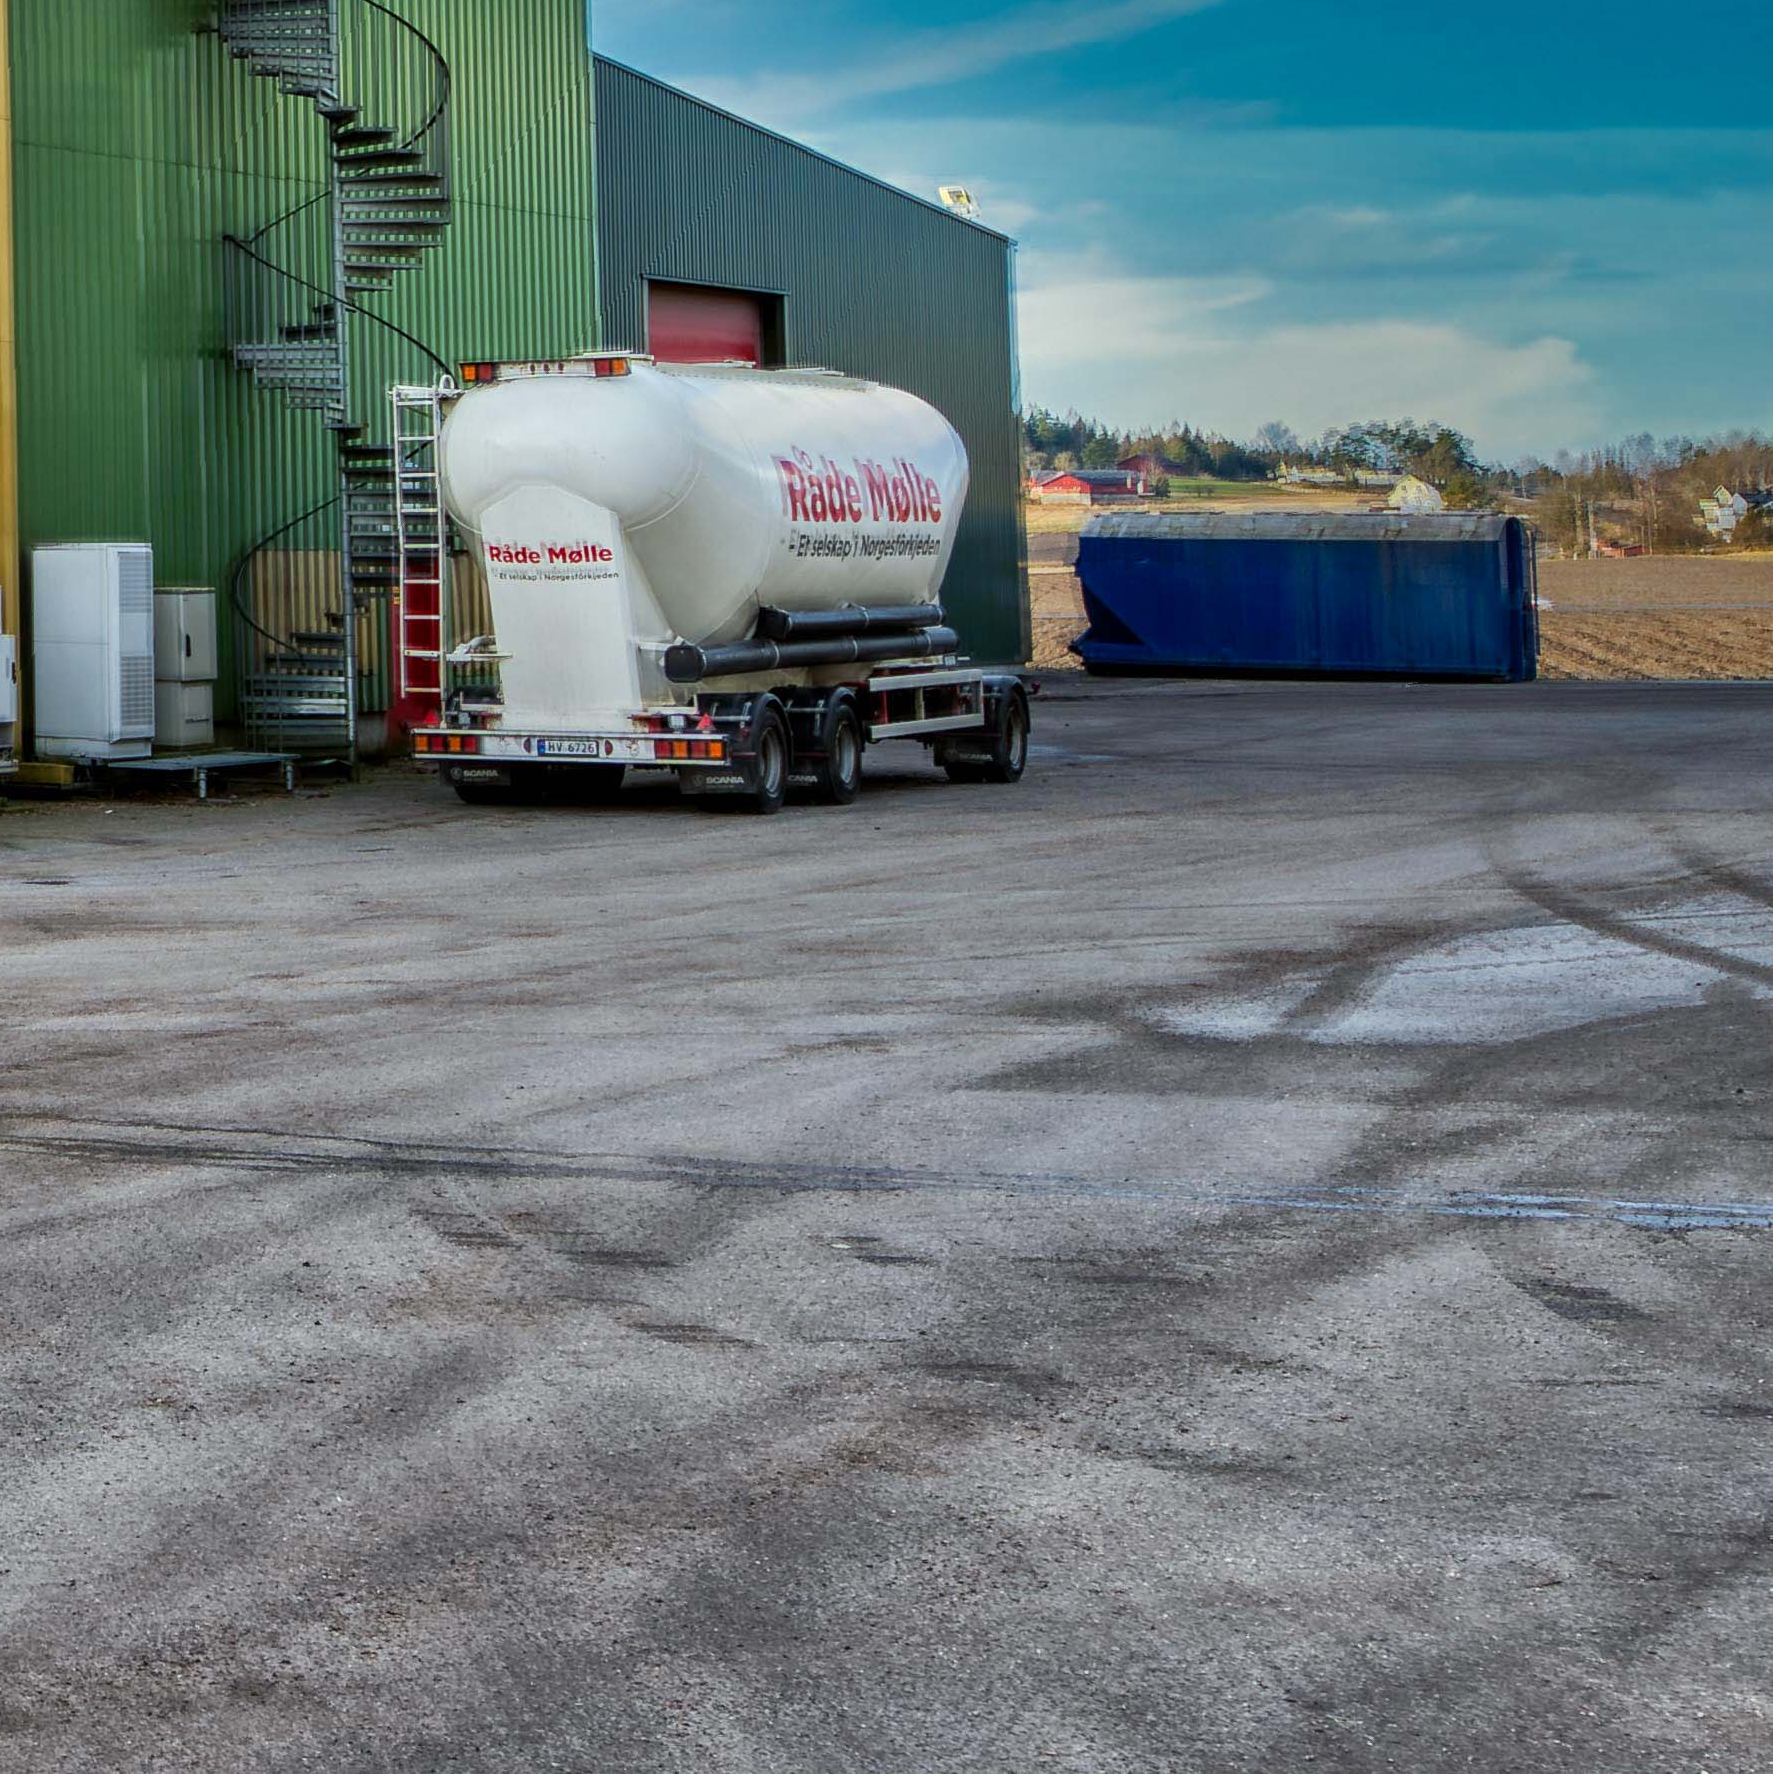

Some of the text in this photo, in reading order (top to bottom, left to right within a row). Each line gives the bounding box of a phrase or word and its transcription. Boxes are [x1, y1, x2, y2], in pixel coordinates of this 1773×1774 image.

[779, 450, 942, 523] Råde Mølle
[796, 534, 810, 557] Et
[810, 534, 851, 562] selskap
[852, 536, 858, 557] i
[489, 545, 613, 564] Råde Mølle
[499, 572, 507, 580] Et
[509, 572, 537, 582] selskap
[547, 741, 595, 753] HV 6726
[463, 769, 499, 777] SCANIA
[787, 774, 818, 782] CANIA
[705, 776, 745, 784] SCANIA
